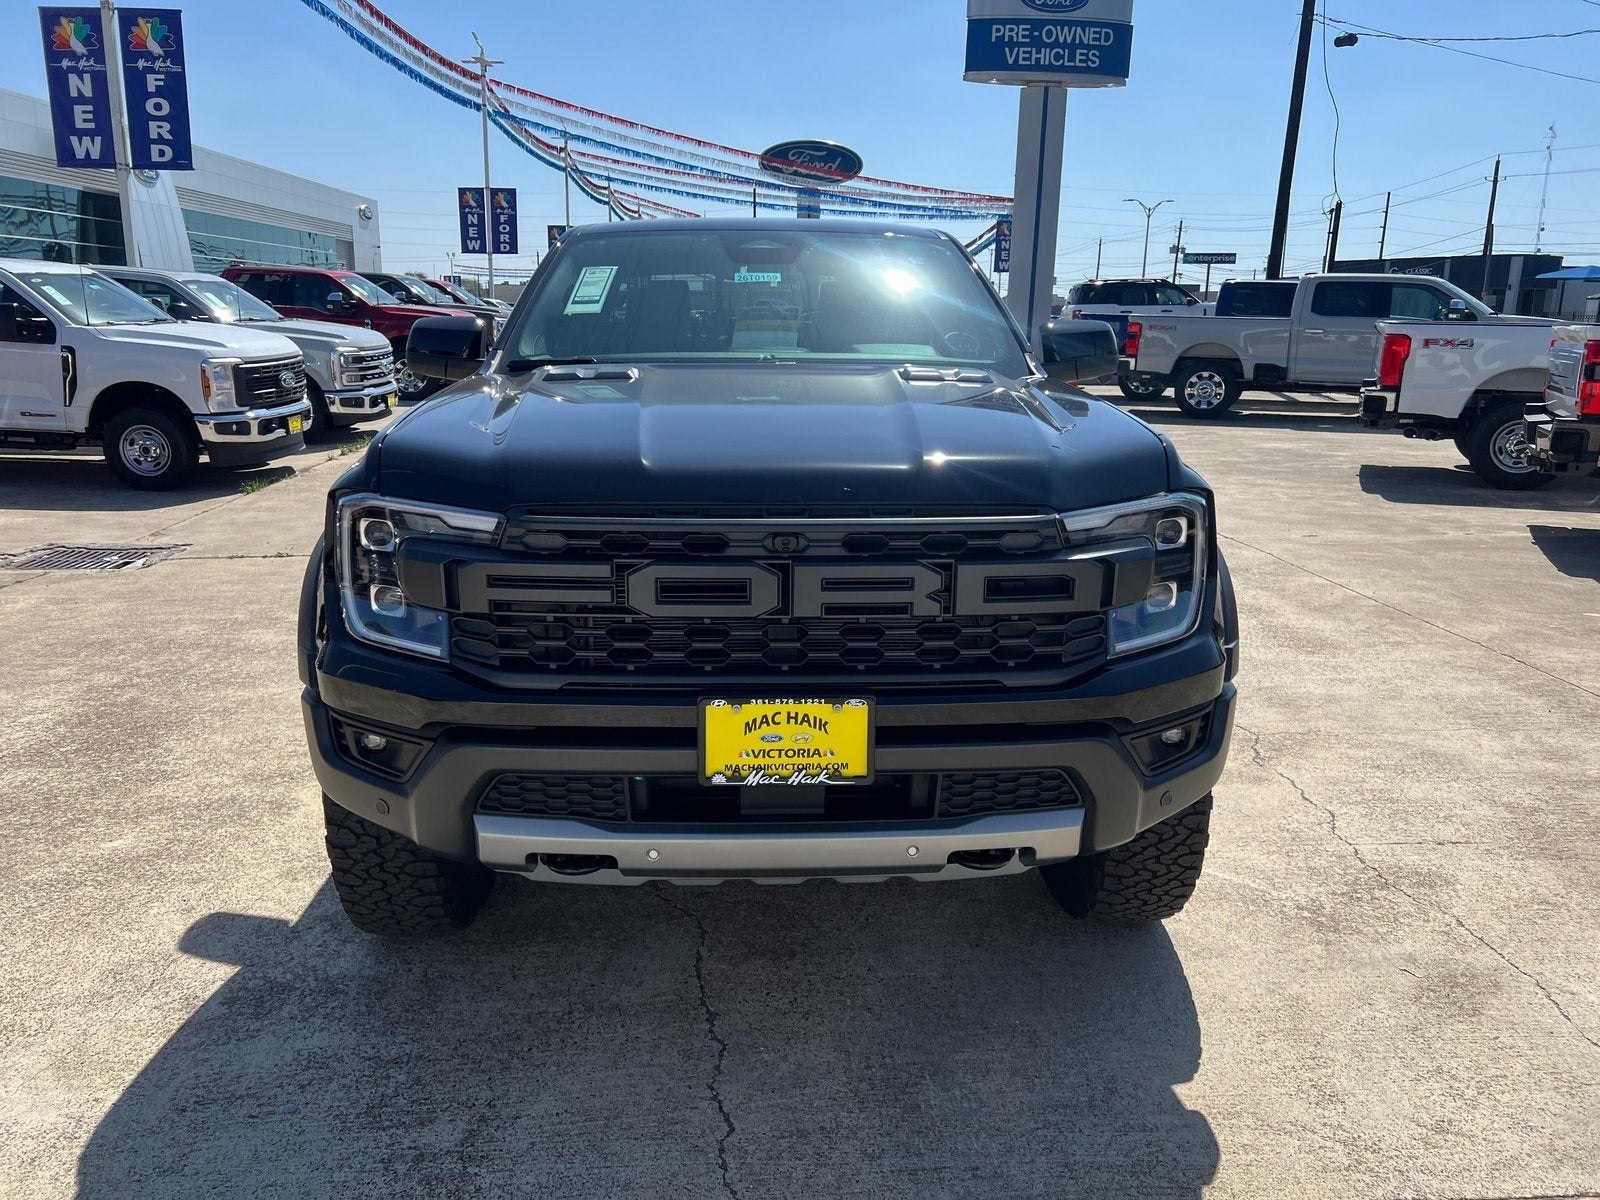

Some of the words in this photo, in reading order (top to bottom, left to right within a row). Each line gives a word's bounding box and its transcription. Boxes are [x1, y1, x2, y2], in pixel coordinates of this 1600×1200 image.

[56, 57, 78, 70] Mac
[78, 56, 100, 70] Haik
[131, 58, 152, 71] Mac
[153, 57, 176, 71] Haik
[1005, 47, 1100, 68] VEHICLES
[68, 73, 102, 160] NEW
[145, 74, 174, 162] FORD
[466, 214, 481, 251] NEW
[498, 214, 511, 252] FORD
[998, 240, 1010, 270] NEW
[1186, 254, 1236, 264] enterprise
[736, 274, 778, 282] 26T0159
[1422, 338, 1474, 348] FX4
[455, 559, 1107, 618] FORD
[743, 711, 782, 736] MAC
[786, 711, 830, 735] HAIK
[750, 748, 823, 759] VICTORIA
[724, 762, 850, 772] MACHAIKVICTORIA.COM
[742, 770, 785, 787] Mac
[785, 769, 836, 786] Haik
